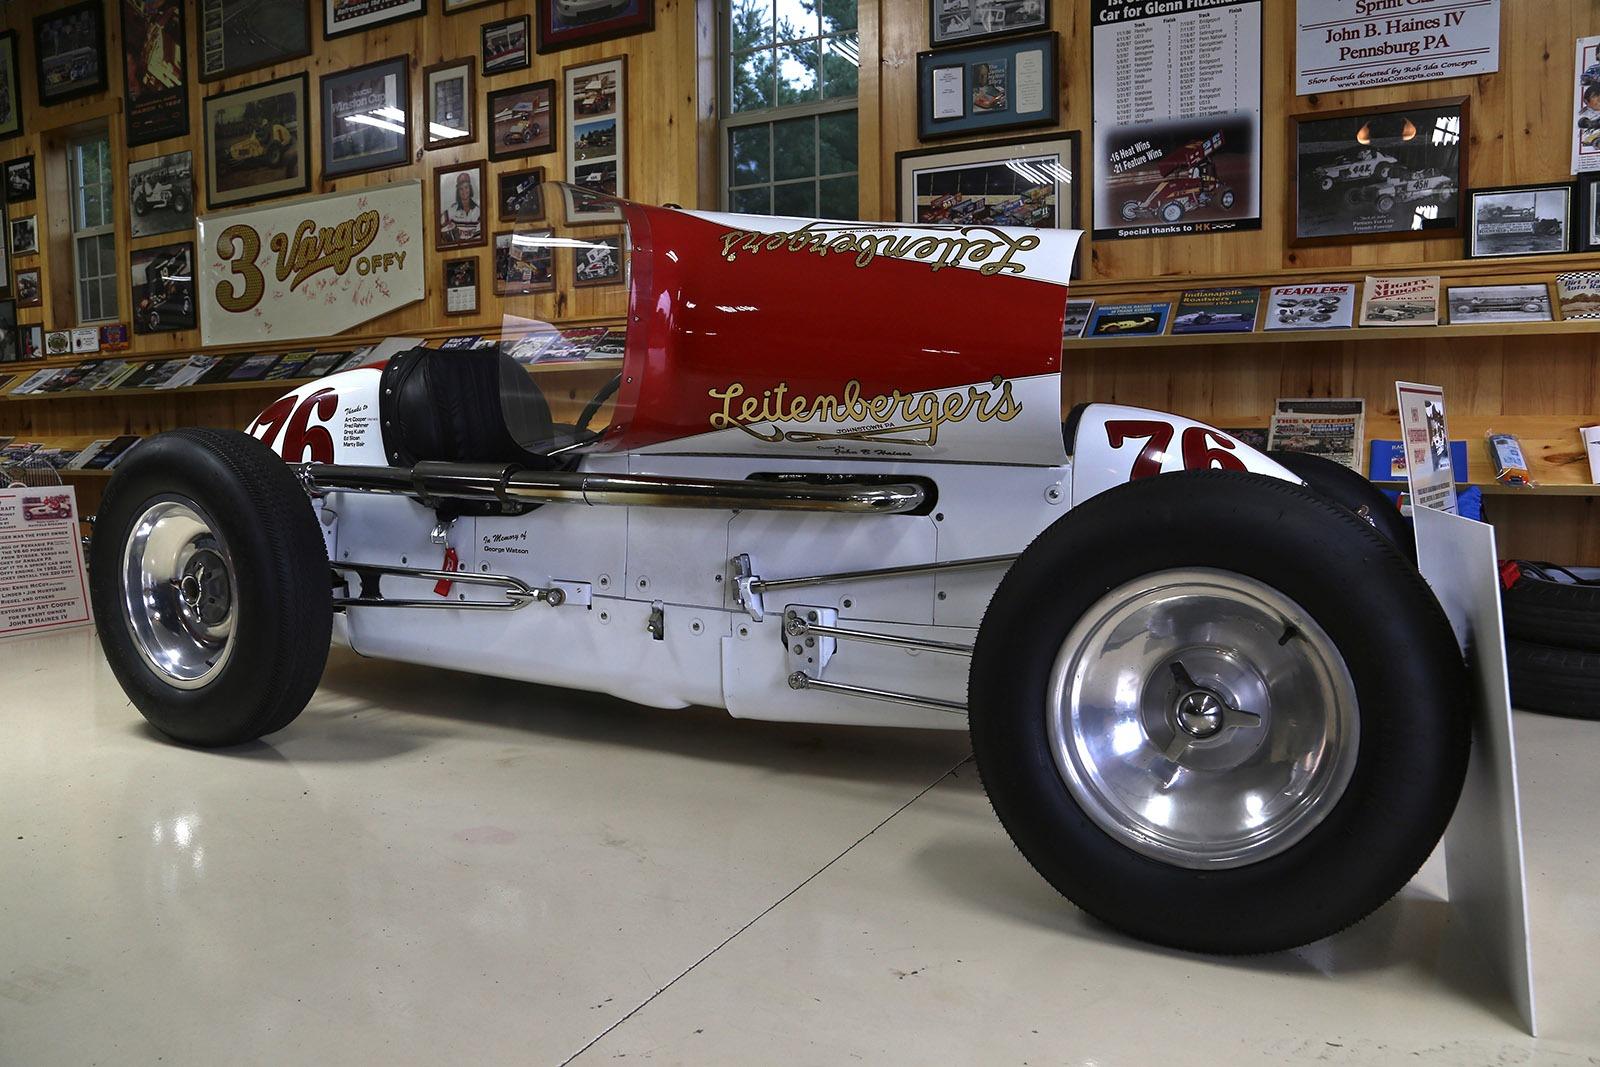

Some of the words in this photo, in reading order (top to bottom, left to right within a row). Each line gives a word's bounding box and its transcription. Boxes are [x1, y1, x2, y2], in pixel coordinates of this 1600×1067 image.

[1099, 9, 1120, 22] Car
[1123, 6, 1142, 18] for
[1145, 1, 1183, 15] Glenn
[1355, 0, 1403, 16] Sprint
[1325, 28, 1360, 43] John
[1364, 24, 1381, 37] B.
[1385, 18, 1440, 35] Haines
[1444, 11, 1466, 27] IV
[1339, 40, 1420, 61] Pennsburg
[1423, 33, 1449, 50] PA
[1308, 78, 1328, 86] Show
[1330, 73, 1356, 83] boards
[1357, 69, 1389, 80] donated
[1391, 68, 1402, 79] by
[1404, 65, 1421, 74] Rob
[1423, 63, 1438, 71] Ida
[1441, 59, 1478, 71] Concepts
[1337, 71, 1444, 88] www.RobIdaConcepts.com
[368, 93, 385, 109] Cup
[1120, 146, 1135, 160] Heat
[1135, 141, 1151, 153] Wins
[1123, 155, 1147, 171] Feature
[1146, 148, 1163, 161] Wins
[1352, 164, 1371, 174] 44K
[1118, 228, 1149, 237] Special
[1152, 225, 1181, 233] thanks
[270, 209, 380, 293] Vargo
[719, 222, 1040, 276] Leitenberger's
[215, 224, 265, 313] 3
[356, 251, 407, 276] OFFY
[1274, 286, 1348, 296] FEARLESS
[1376, 278, 1430, 290] MIGHTY
[1563, 279, 1583, 288] Dirt
[1184, 290, 1243, 298] Indianapolis
[344, 406, 362, 416] Thanks
[708, 375, 1023, 446] Leitenberger's
[250, 387, 339, 465] 76
[836, 424, 883, 434] JOHNSTOWN
[1104, 420, 1248, 482] 76
[483, 536, 491, 545] In
[492, 533, 519, 543] Memory
[520, 531, 528, 540] of
[484, 546, 505, 555] George
